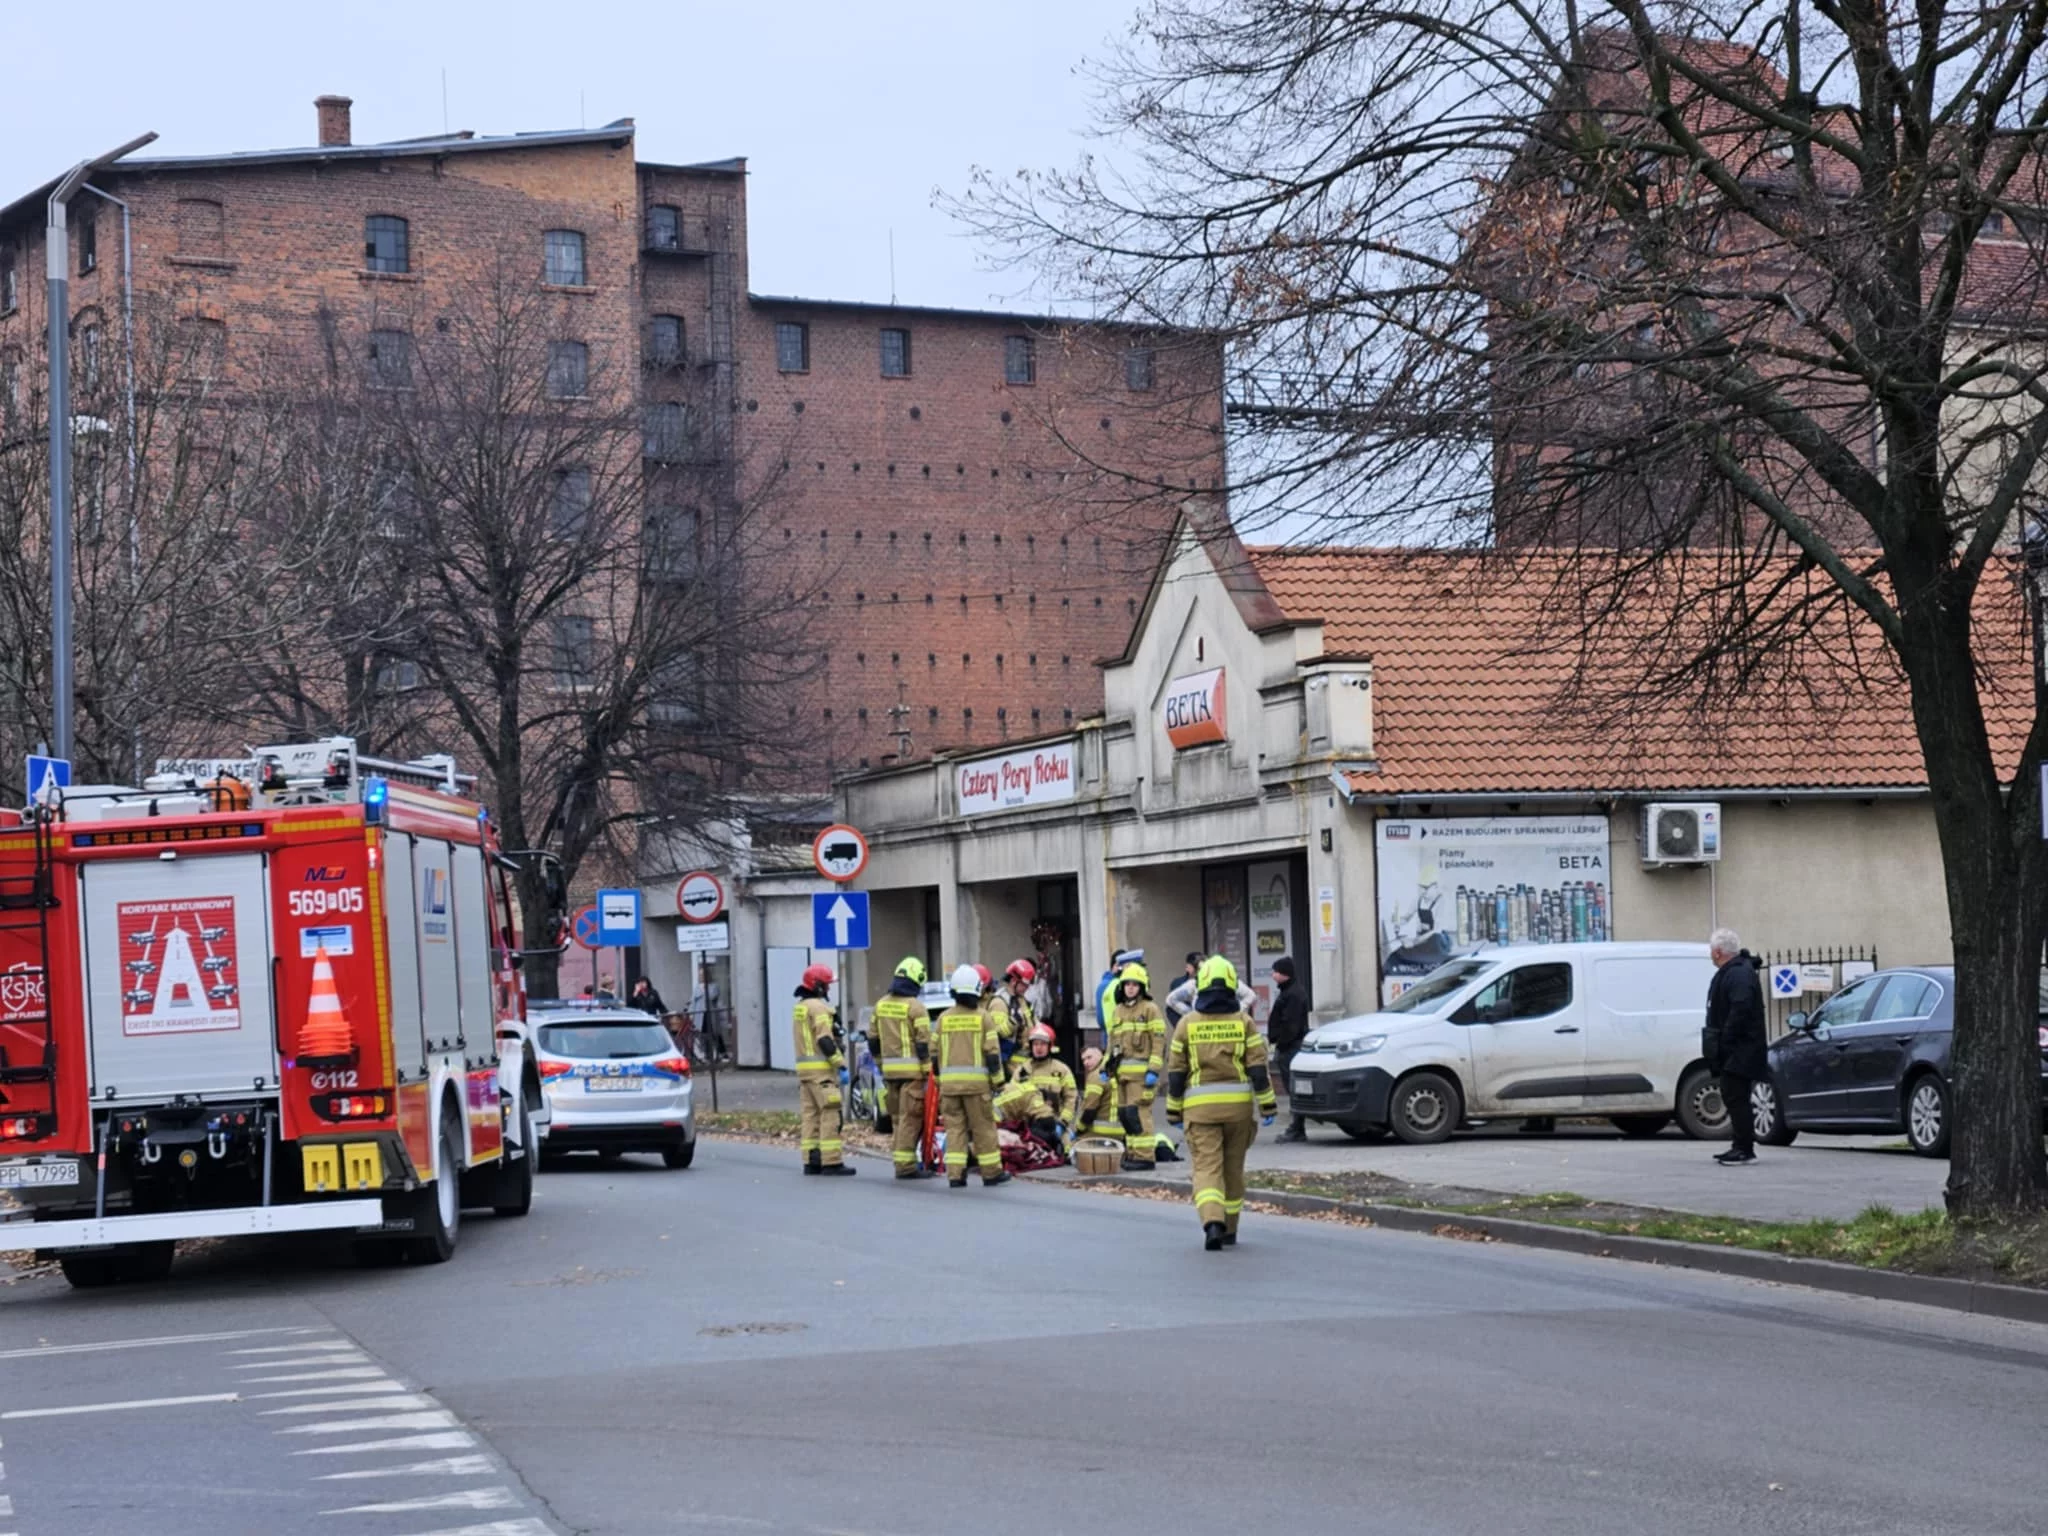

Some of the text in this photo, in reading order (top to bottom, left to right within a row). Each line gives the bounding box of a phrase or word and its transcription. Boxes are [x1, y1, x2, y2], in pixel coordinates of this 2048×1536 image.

[1165, 688, 1212, 729] BETA
[961, 752, 1069, 802] Cztery Pory Roku
[1432, 827, 1463, 836] RAZEM
[1465, 827, 1514, 836] BUDUJEMY
[1515, 826, 1566, 836] SPRAWNIEJ
[1445, 859, 1495, 869] pianokleje
[1559, 856, 1602, 869] BETA
[121, 900, 232, 915] KORYTARZ RATUNKOWY
[328, 1071, 358, 1088] 112
[33, 1164, 77, 1182] 17998
